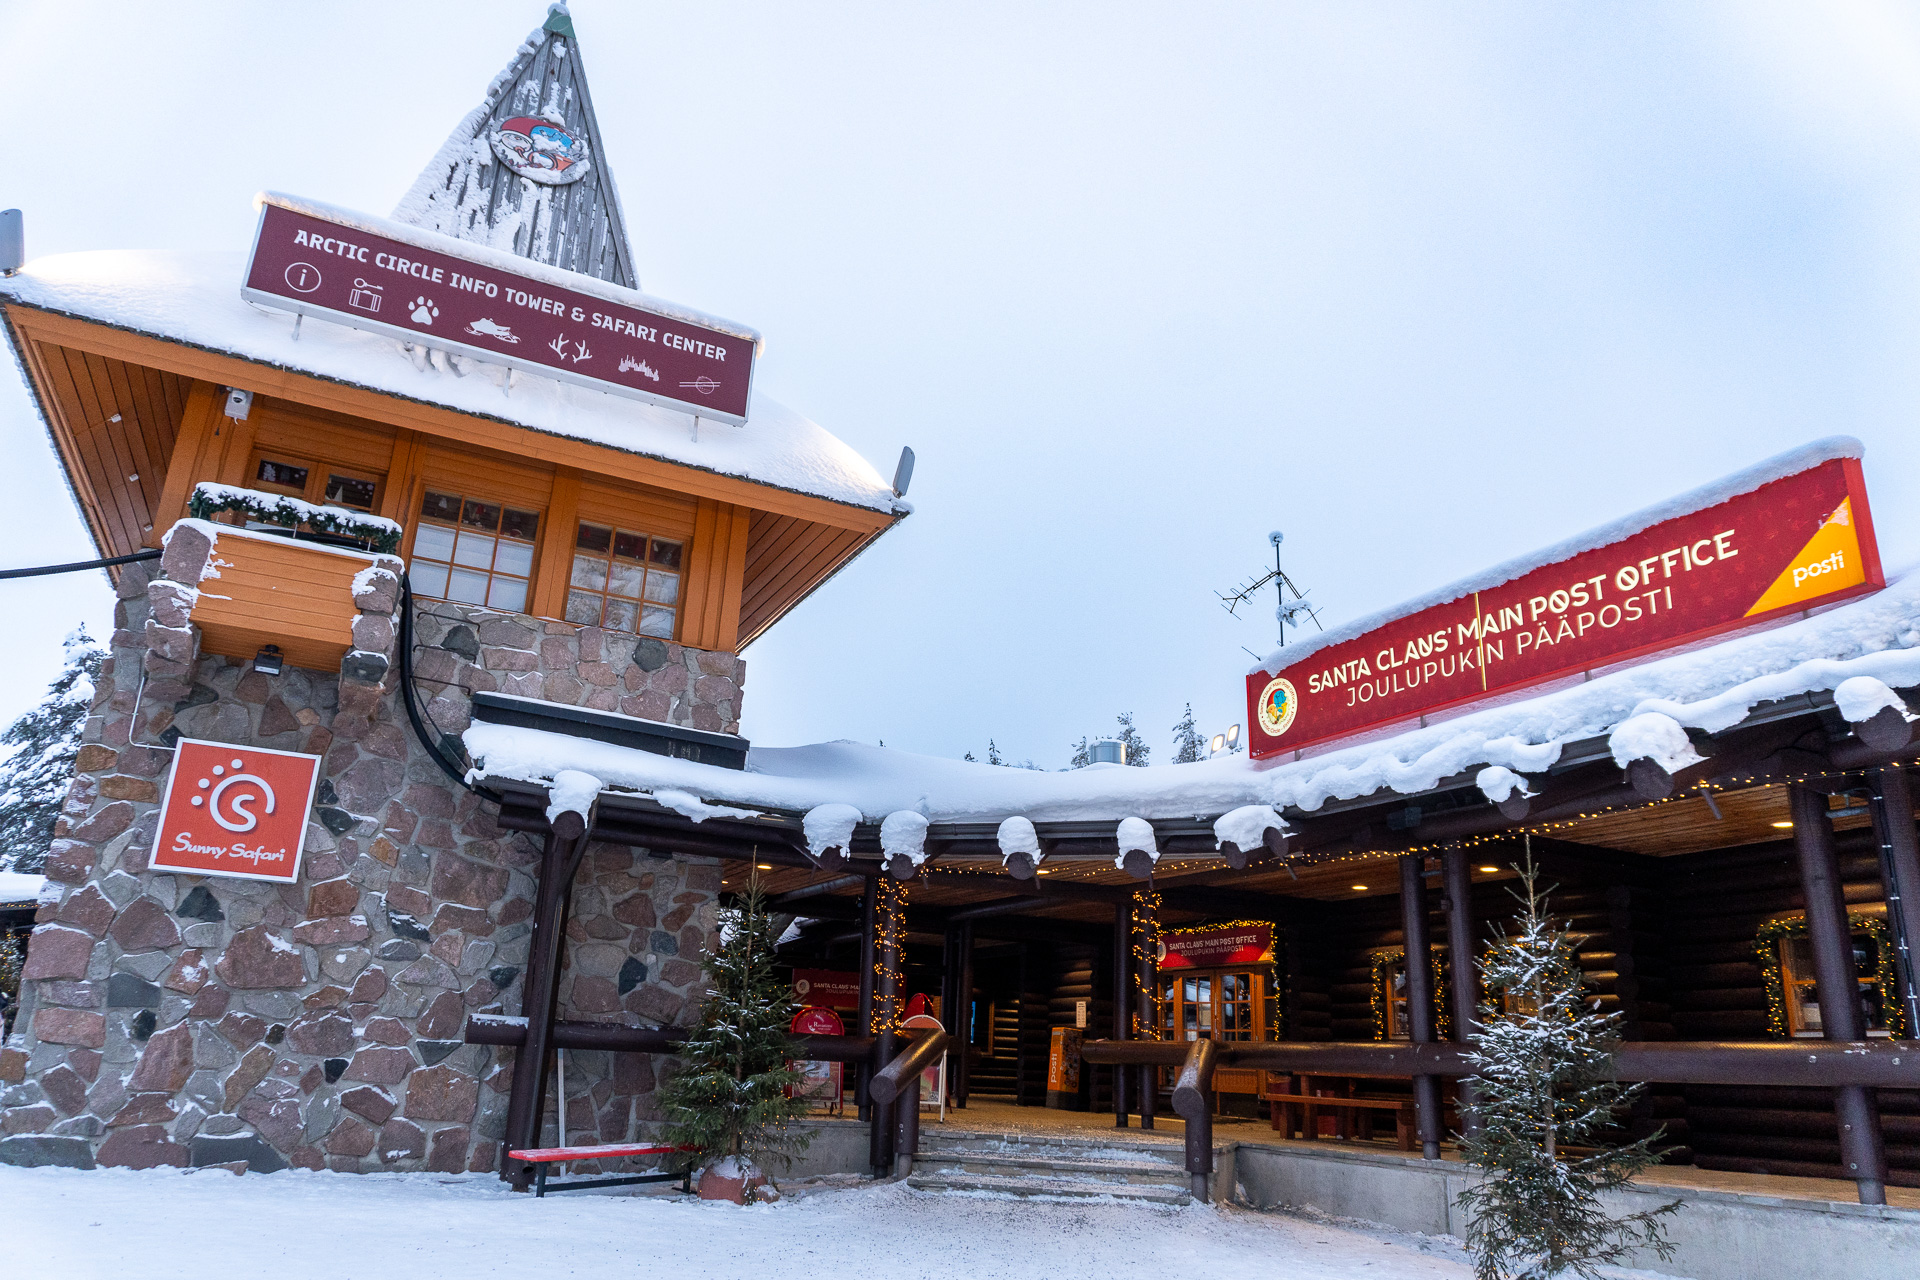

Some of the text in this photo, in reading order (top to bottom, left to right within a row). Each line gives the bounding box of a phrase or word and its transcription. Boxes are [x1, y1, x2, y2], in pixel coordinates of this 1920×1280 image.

[294, 229, 727, 362] ARCTIC CIRCLE INFO TOWER & SAFARI CENTER
[1792, 549, 1845, 588] posti
[1308, 657, 1372, 694] SANTA
[1457, 603, 1524, 645] MAIN
[1528, 574, 1607, 622] POST
[1615, 529, 1739, 591] OFFICE
[1347, 586, 1673, 707] JOULUPUKIN PÄÄPOSTI
[172, 832, 286, 866] Sunny Safari
[1168, 942, 1185, 951] SANTA
[1204, 939, 1220, 948] MAIN
[1235, 934, 1257, 944] OFFICE
[1050, 1053, 1058, 1083] posti
